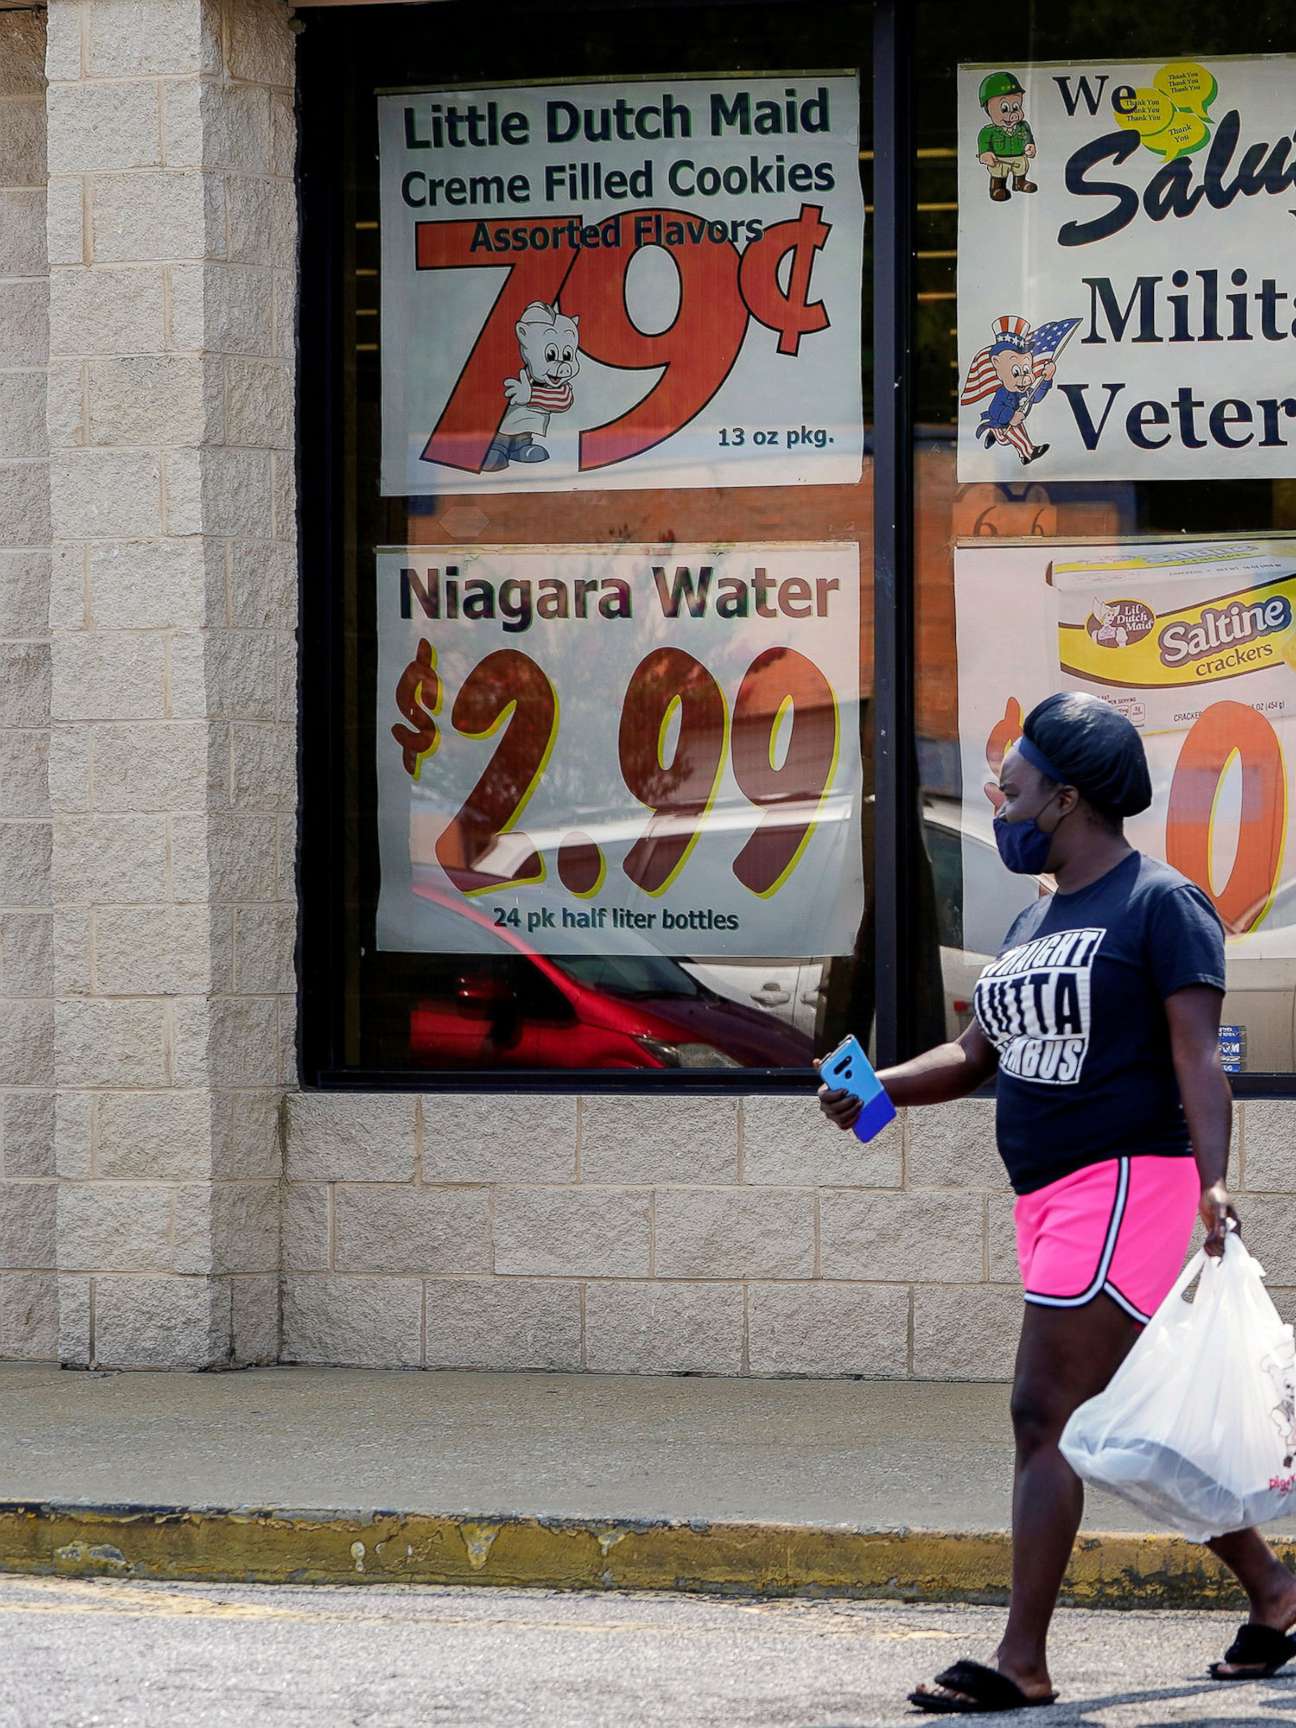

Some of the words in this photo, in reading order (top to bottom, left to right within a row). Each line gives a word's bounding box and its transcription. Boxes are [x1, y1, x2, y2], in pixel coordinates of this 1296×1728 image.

[1053, 74, 1137, 116] We
[404, 101, 529, 149] Little
[545, 94, 692, 144] Dutch
[709, 87, 830, 137] Maid
[1168, 124, 1192, 136] Thank
[1174, 135, 1190, 143] You
[401, 171, 531, 208] Creme
[545, 160, 654, 201] Filled
[668, 154, 836, 197] Cookies
[470, 217, 621, 253] Assorted
[634, 214, 765, 248] Flavors
[415, 203, 833, 475] 79¢
[718, 427, 745, 447] 13
[753, 430, 779, 446] oz
[786, 426, 835, 451] pkg.
[400, 566, 633, 632] Niagara
[652, 566, 840, 619] Water
[1116, 612, 1148, 624] Dutch
[1126, 620, 1152, 632] Maid
[1161, 599, 1288, 664] Saltine
[1195, 643, 1273, 678] crackers
[391, 638, 841, 899] $2.99
[493, 908, 521, 929] 24
[528, 907, 556, 932] pk
[562, 907, 607, 929] half
[612, 908, 657, 929] liter
[662, 908, 739, 931] bottles
